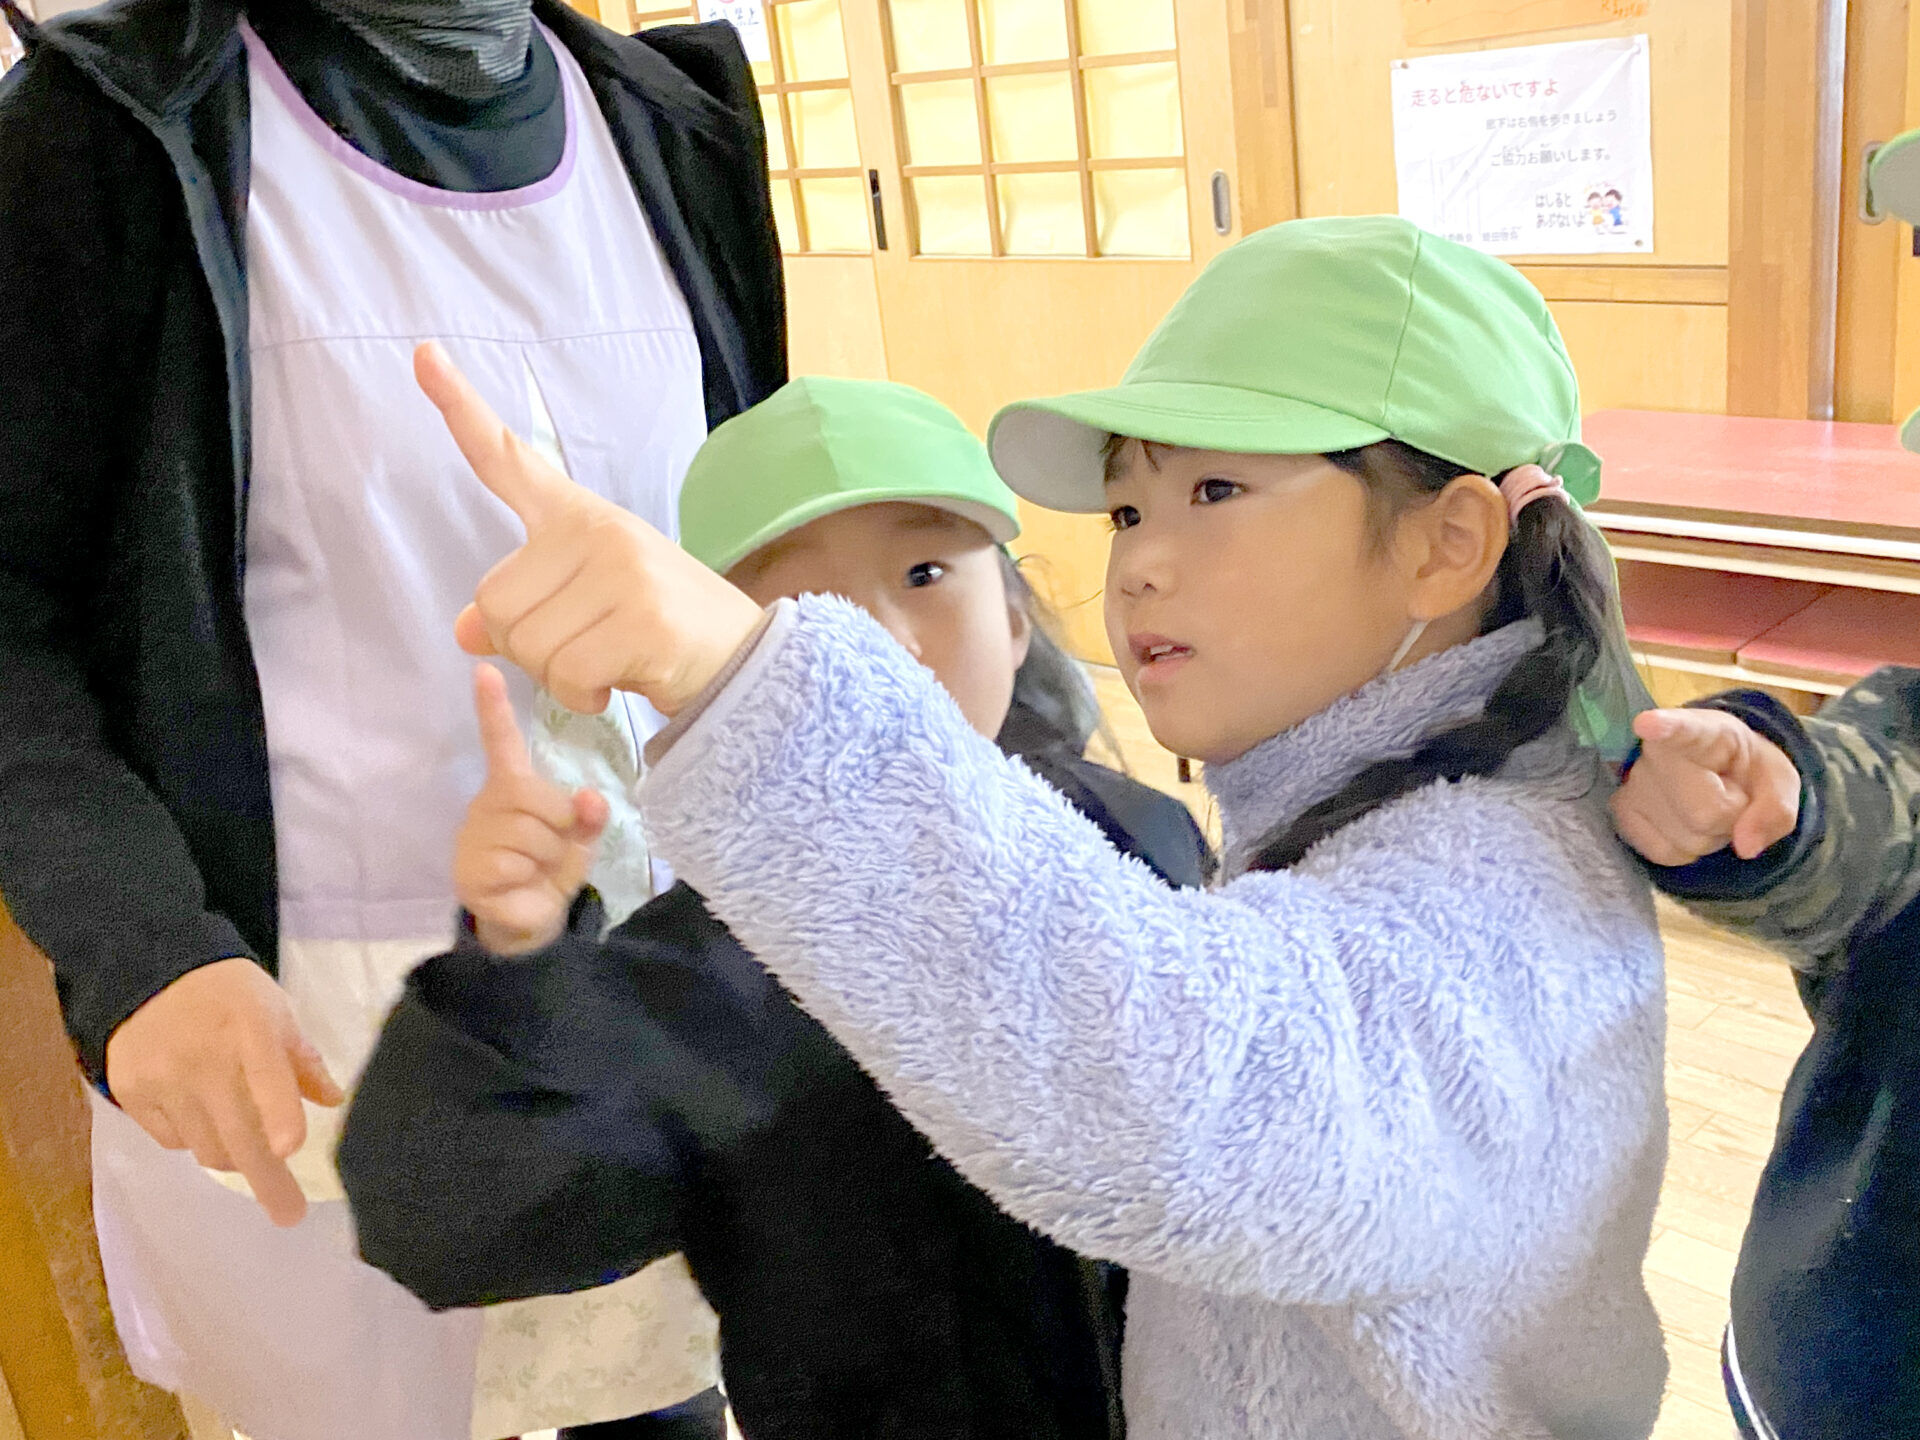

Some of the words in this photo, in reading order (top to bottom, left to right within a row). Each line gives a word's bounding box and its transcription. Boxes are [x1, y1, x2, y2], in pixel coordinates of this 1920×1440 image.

[1411, 79, 1559, 107] 走ると危ないですよ
[1536, 192, 1572, 208] はしると
[1536, 211, 1587, 229] あぶないよ
